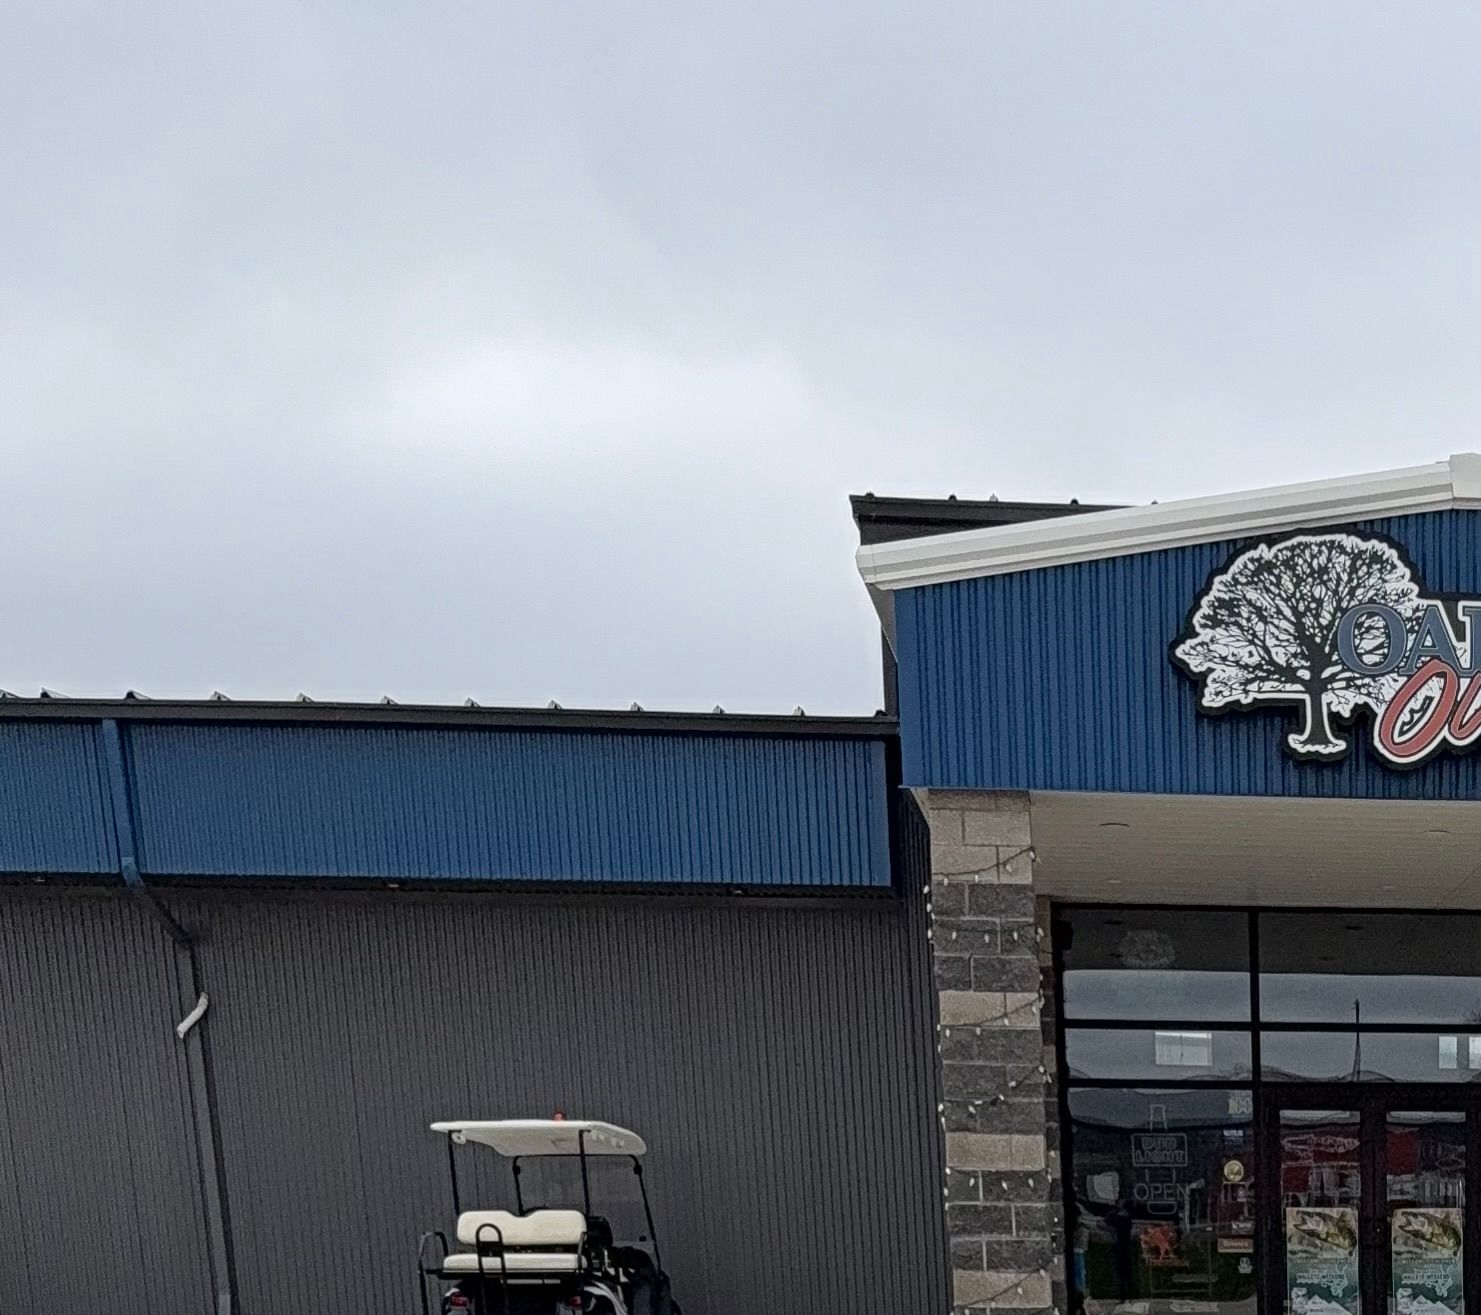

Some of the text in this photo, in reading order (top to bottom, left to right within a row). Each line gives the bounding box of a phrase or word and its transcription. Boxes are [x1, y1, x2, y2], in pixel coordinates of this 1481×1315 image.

[1141, 1136, 1177, 1150] BUD
[1135, 1150, 1185, 1163] LIGHT
[1133, 1183, 1188, 1200] OPEN
